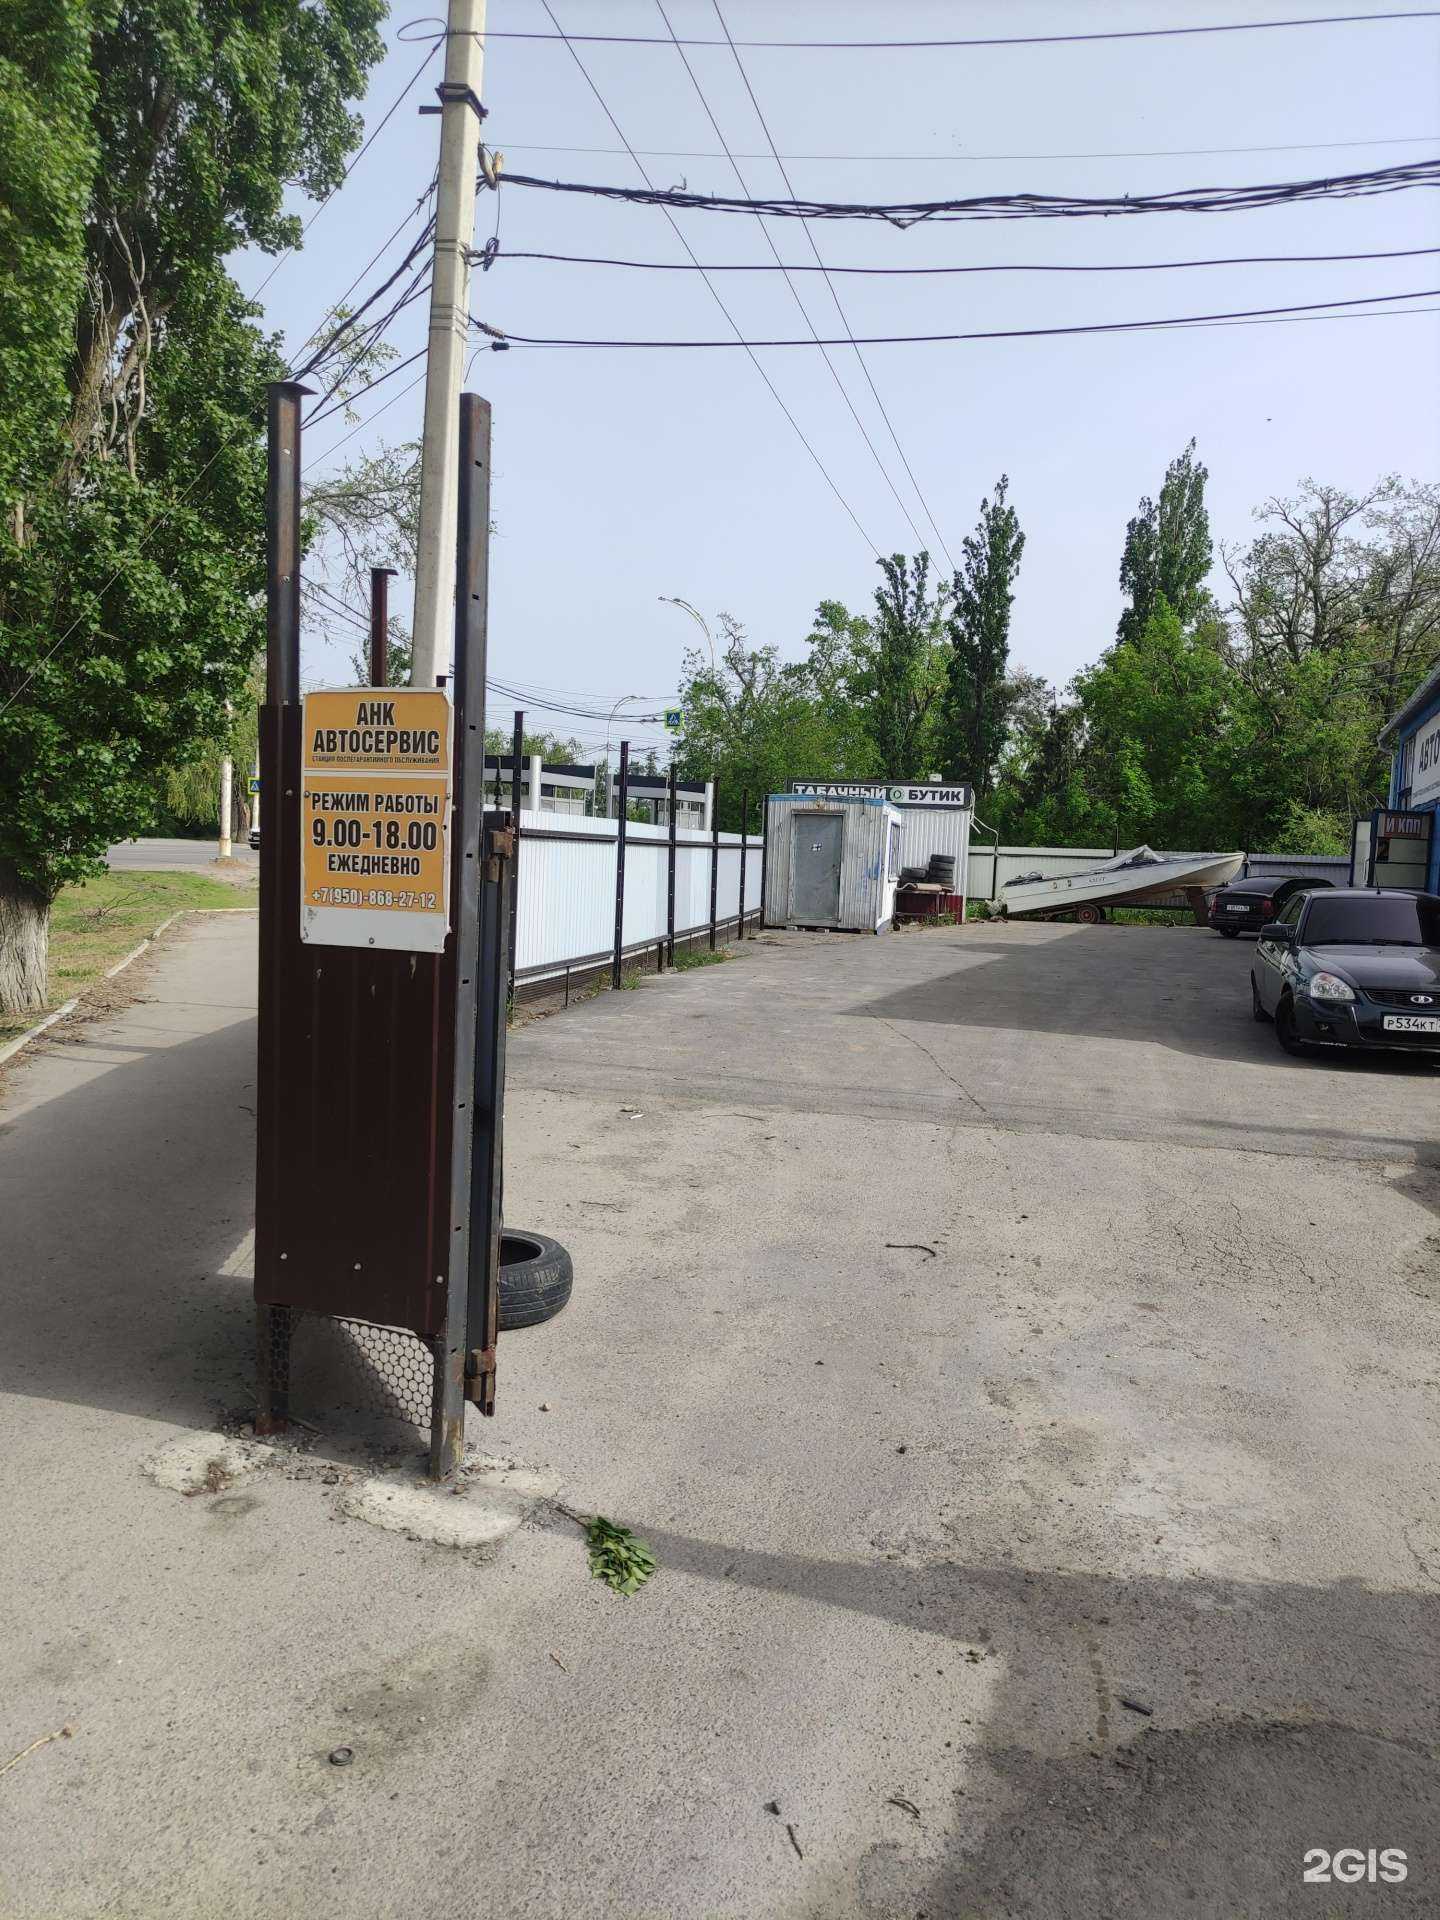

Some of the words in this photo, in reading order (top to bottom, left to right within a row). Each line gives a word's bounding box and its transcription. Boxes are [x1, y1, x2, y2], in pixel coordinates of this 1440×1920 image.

[356, 702, 395, 727] АНК
[313, 730, 440, 754] АВТОСЕРВИС
[311, 792, 370, 812] РЕЖИМ
[374, 794, 438, 814] РАБОТЫ
[908, 789, 962, 802] БУТИК
[312, 818, 437, 851] 9.00-18.00
[327, 853, 421, 876] ЕЖЕДНЕВНО
[312, 887, 436, 910] +7(950)-868-27-12
